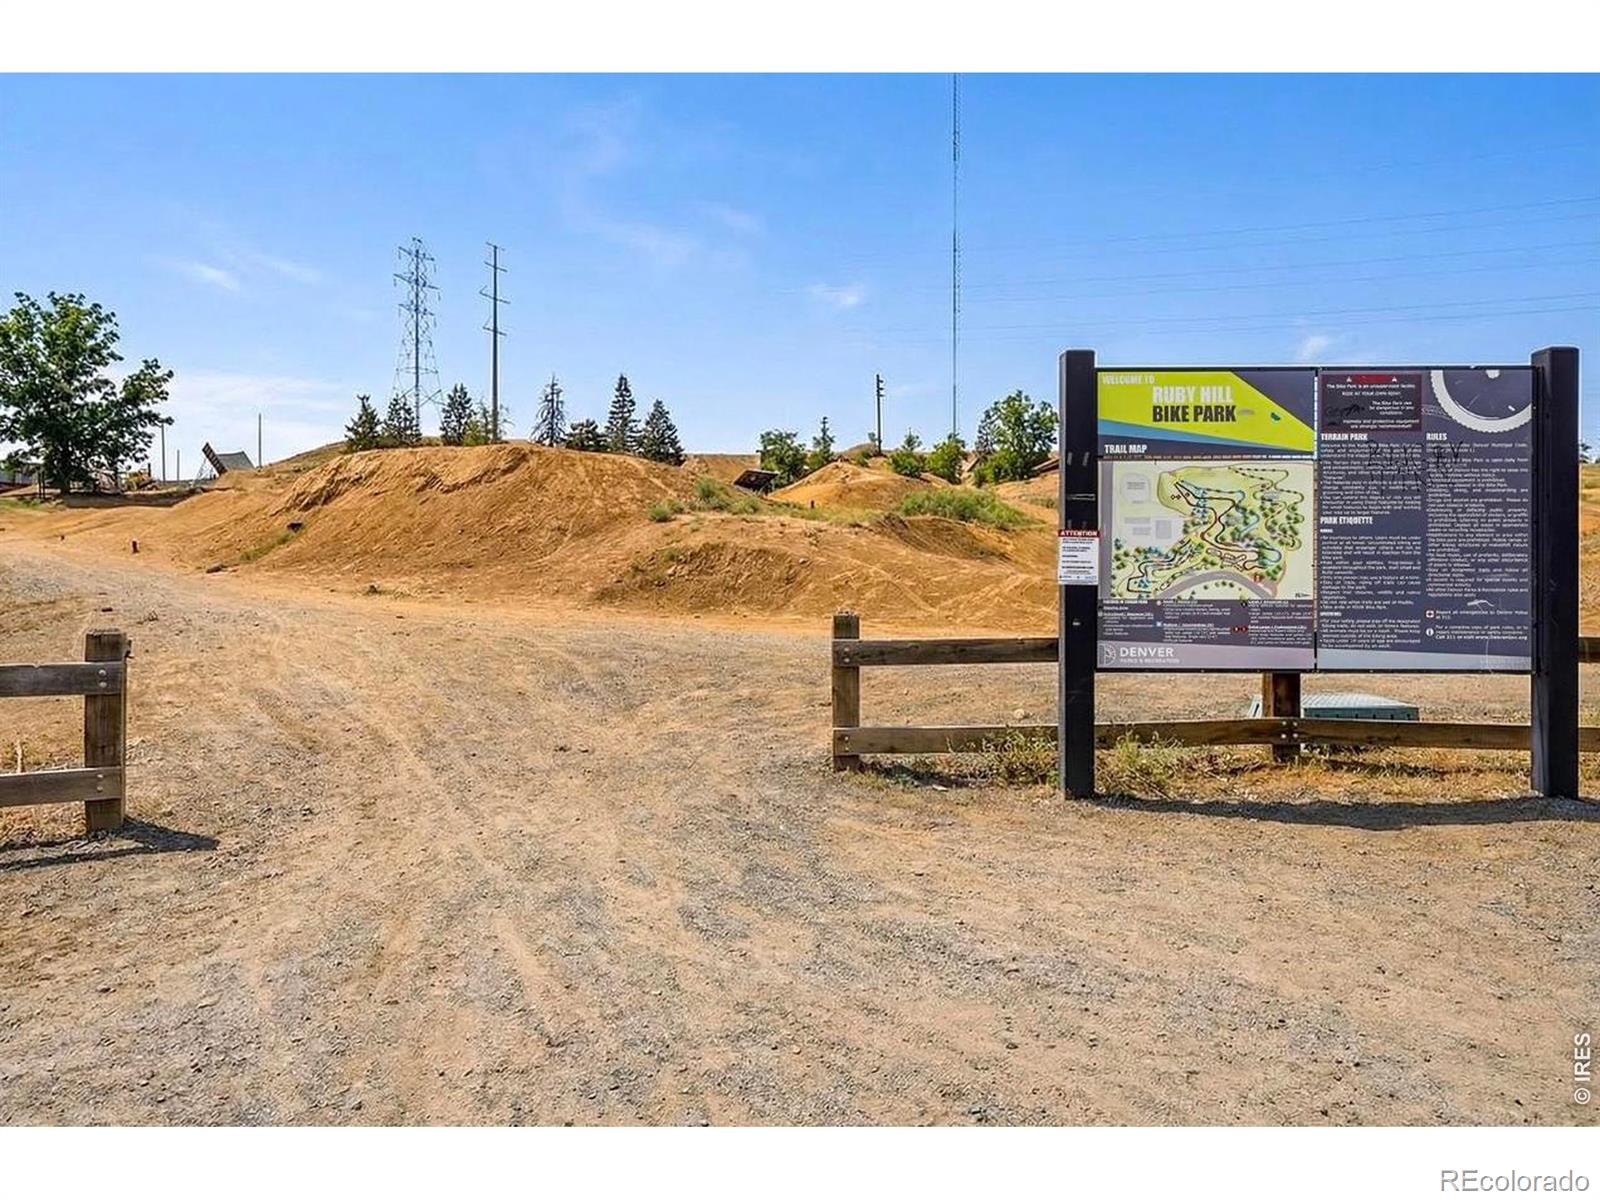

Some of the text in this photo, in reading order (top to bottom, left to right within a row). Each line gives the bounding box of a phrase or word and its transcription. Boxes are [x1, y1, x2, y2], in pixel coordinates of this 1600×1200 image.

[1102, 375, 1154, 385] WELCOME TO
[1152, 386, 1233, 403] RUBY HILL
[1152, 405, 1190, 422] BIKE
[1193, 405, 1236, 422] PARK
[1321, 432, 1368, 441] TERRAIN PARK
[1426, 432, 1448, 441] RULES
[1104, 444, 1148, 454] TRAIL MAP
[1320, 516, 1373, 525] PARK ETIQUETTE
[1120, 647, 1174, 657] DENVER
